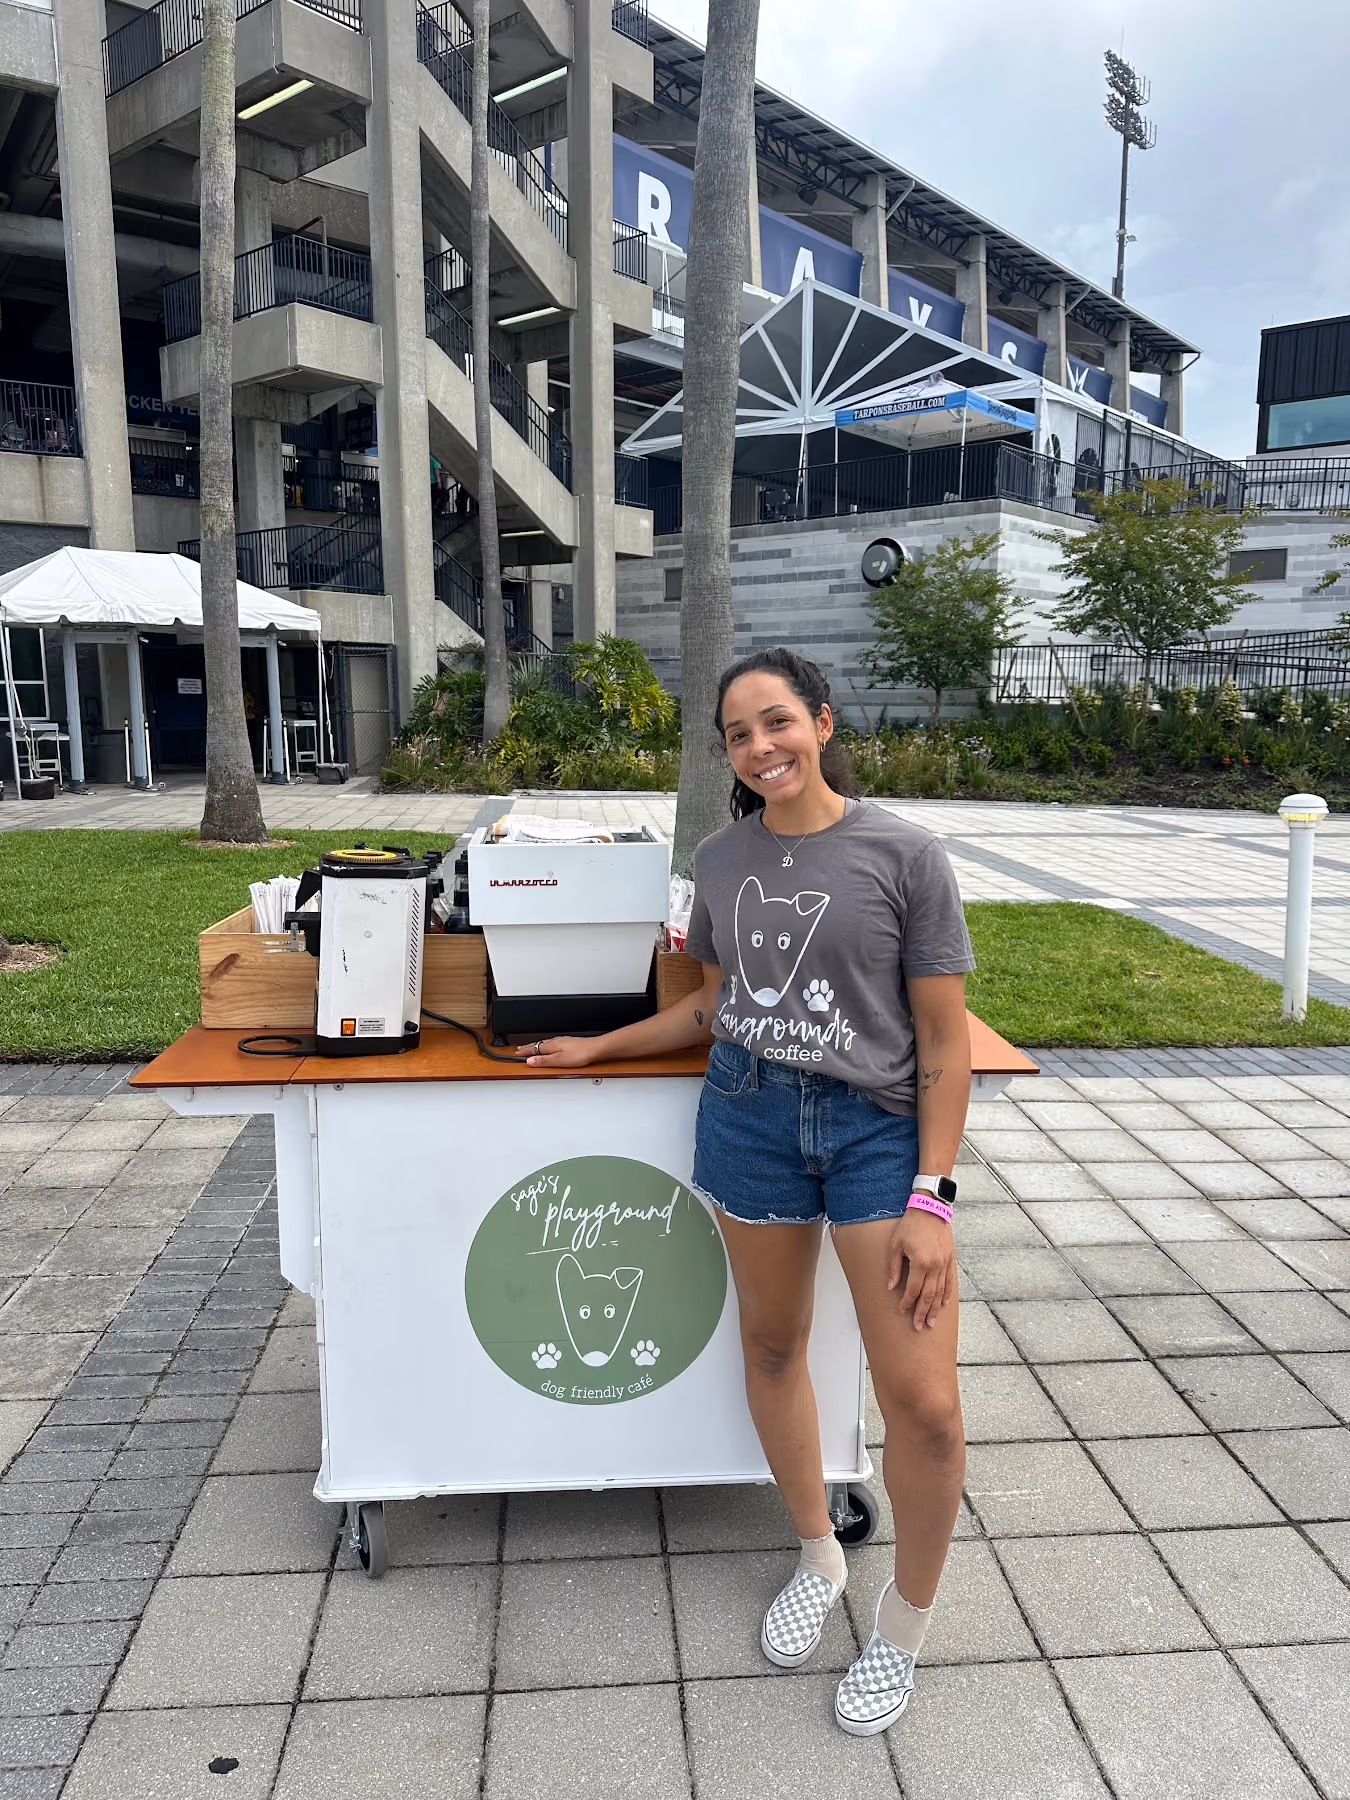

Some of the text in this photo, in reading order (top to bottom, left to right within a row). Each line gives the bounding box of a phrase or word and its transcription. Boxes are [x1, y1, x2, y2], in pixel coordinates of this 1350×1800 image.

[853, 397, 945, 420] TARPONSBASEBALL.COM
[763, 1044, 823, 1062] coffee
[510, 1175, 560, 1216] sage's
[542, 1185, 681, 1252] playground
[540, 1372, 654, 1399] dog friendly café
